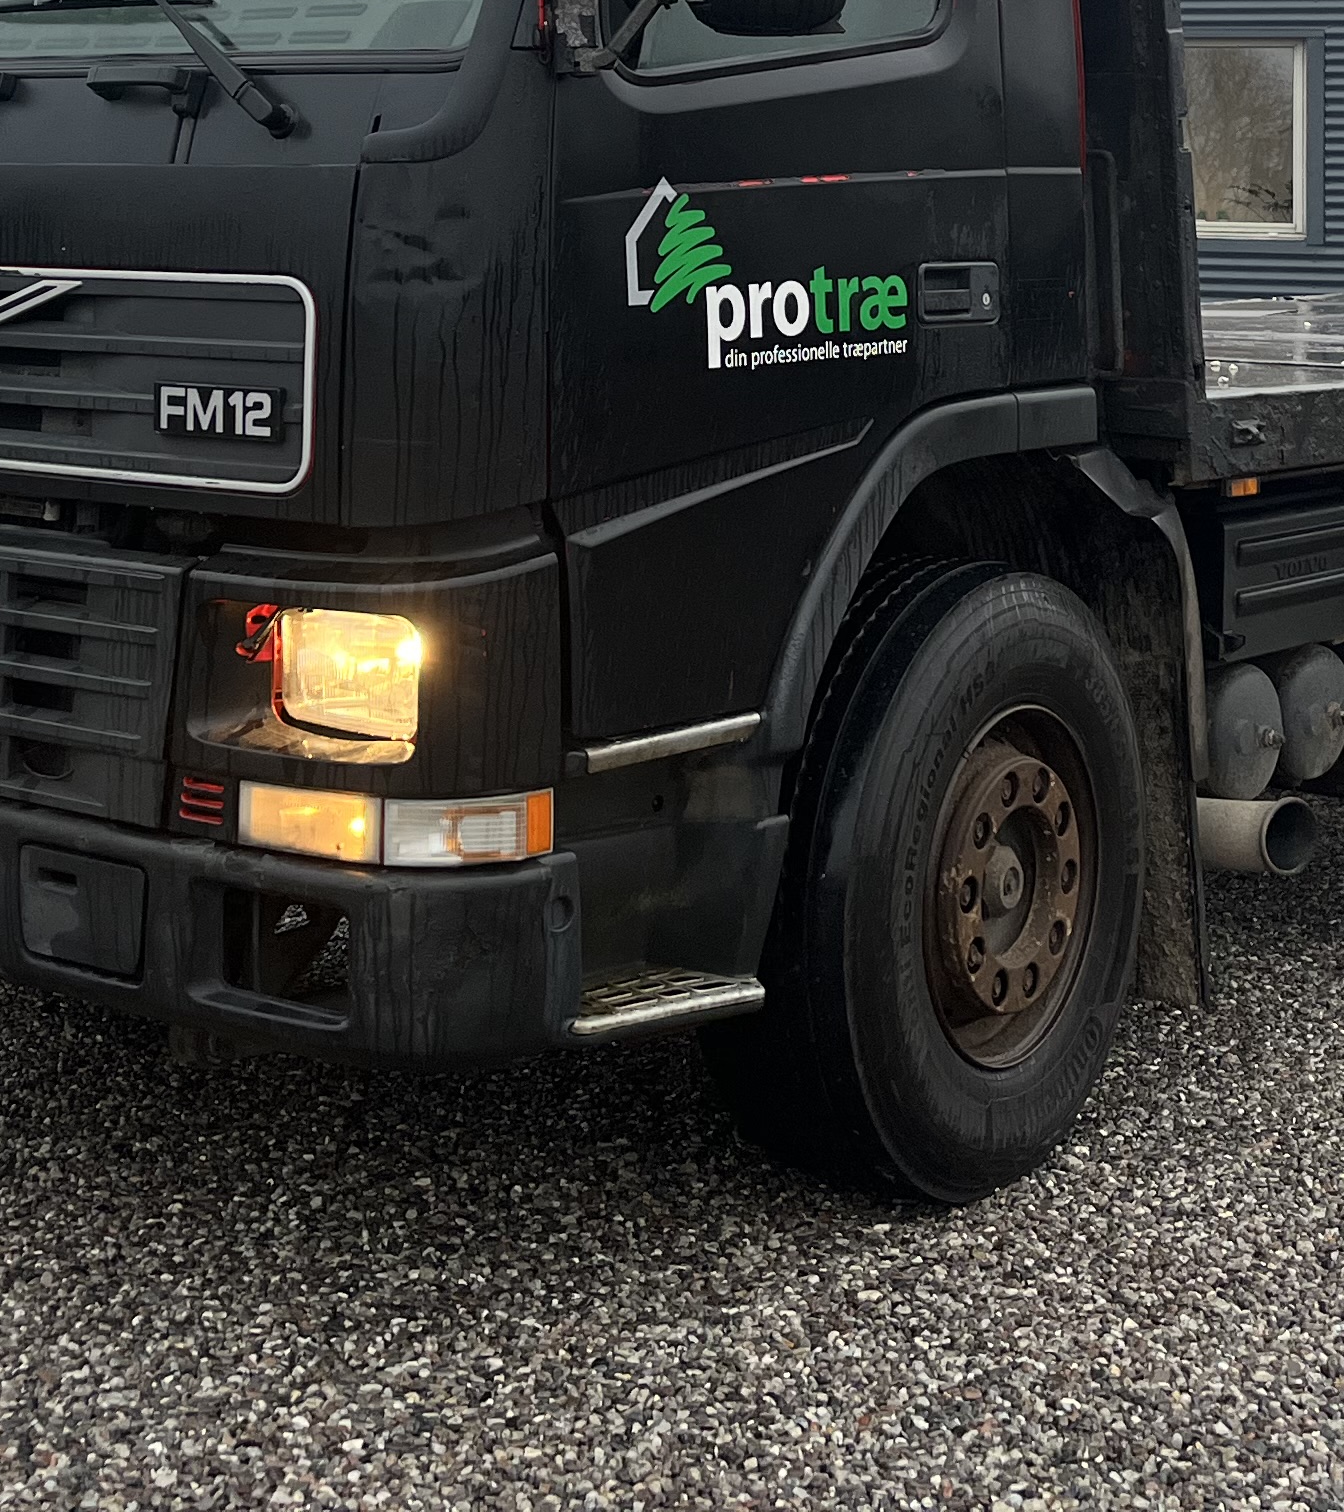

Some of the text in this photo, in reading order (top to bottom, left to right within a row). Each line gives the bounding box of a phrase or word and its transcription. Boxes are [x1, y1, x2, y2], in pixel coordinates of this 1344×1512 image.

[705, 265, 908, 369] protræ
[725, 339, 908, 370] din professionelle træpartner
